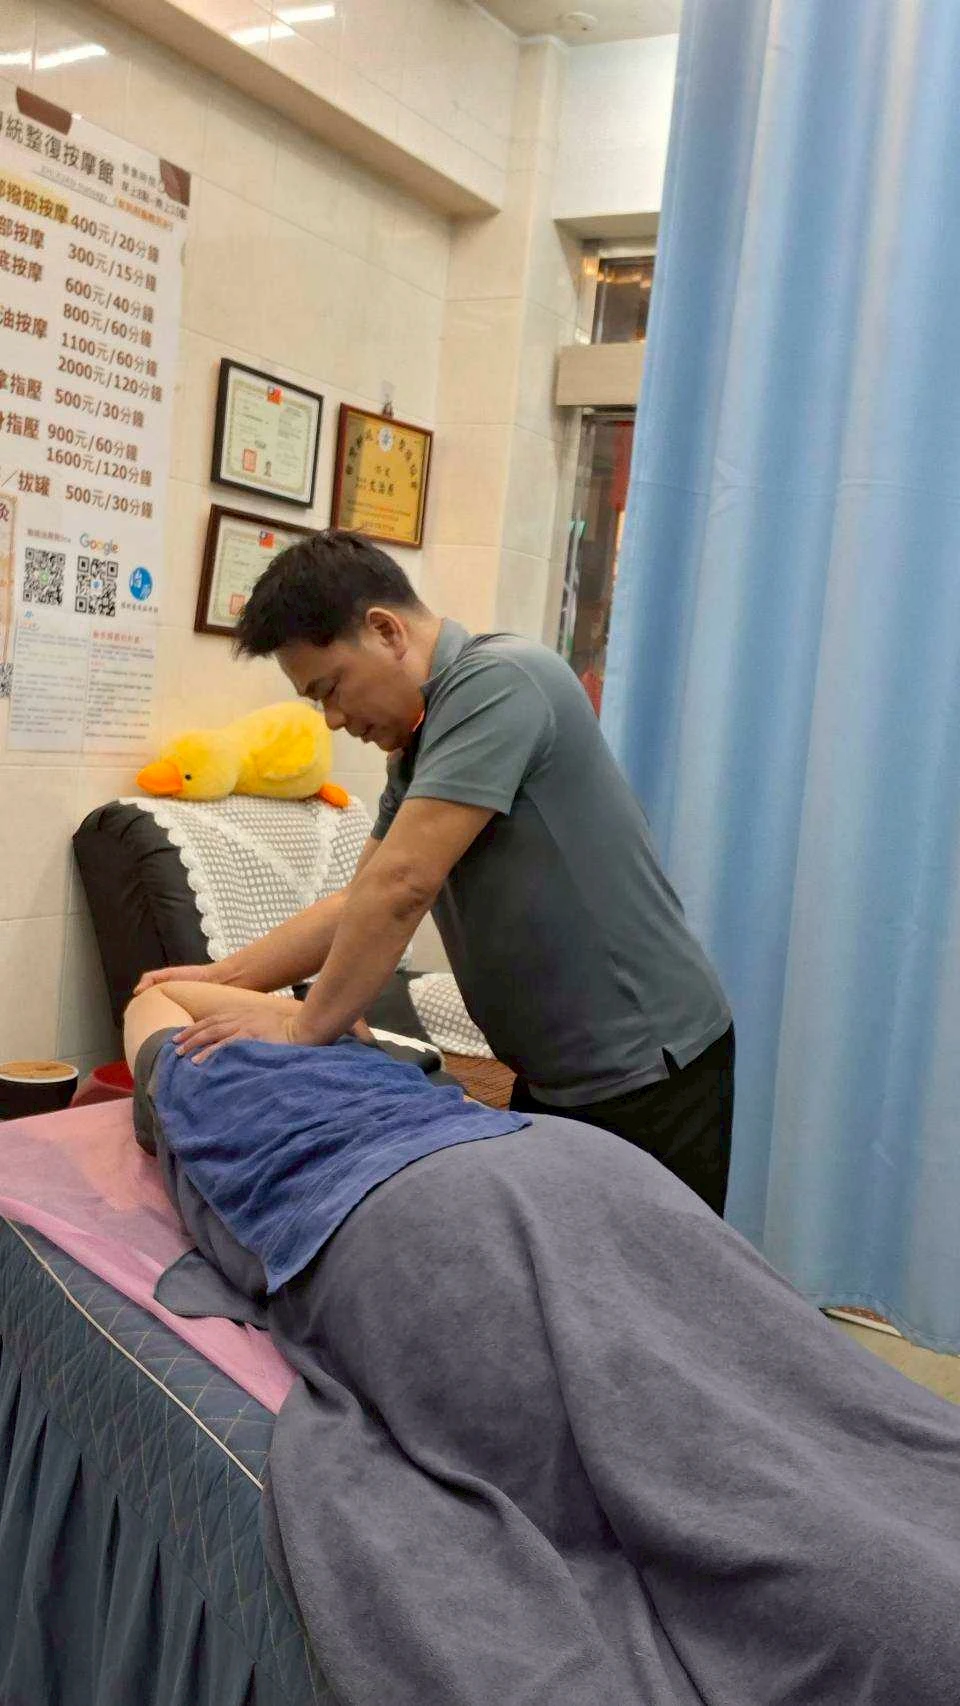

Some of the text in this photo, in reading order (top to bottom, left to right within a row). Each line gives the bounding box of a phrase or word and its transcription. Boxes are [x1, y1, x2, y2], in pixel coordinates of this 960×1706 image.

[0, 111, 115, 185] 統整復按摩館
[71, 214, 161, 264] 400元/20分鐘
[67, 243, 158, 293] 300元/15分鐘
[65, 277, 155, 324] 600元/40分鐘
[63, 303, 153, 348] 800元/60分鐘
[61, 332, 158, 378] 1100元/60分鐘
[58, 355, 163, 402] 2000元/120分鐘
[54, 388, 145, 428] 500元/30分鐘
[47, 424, 139, 461] 900元/60分鐘
[47, 447, 153, 487] 1600元/120分鐘
[65, 485, 153, 519] 500元/30分鐘
[79, 532, 120, 556] Google
